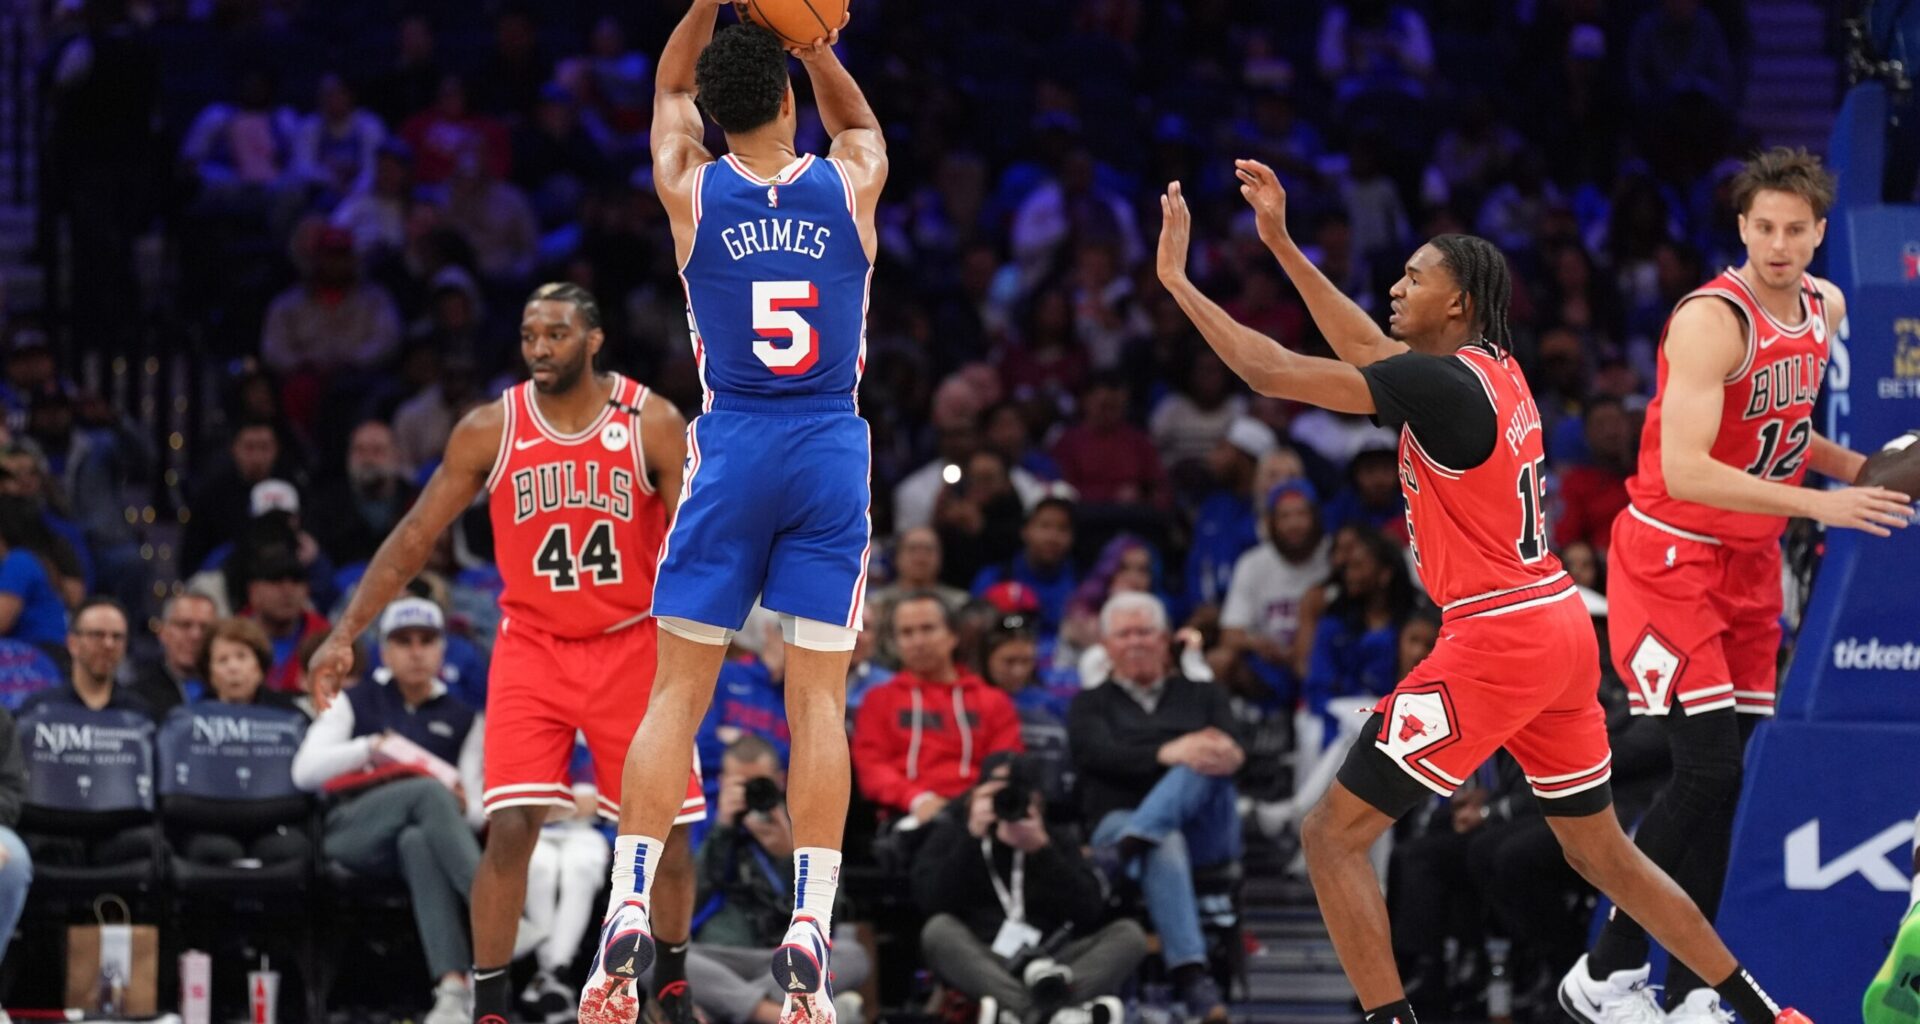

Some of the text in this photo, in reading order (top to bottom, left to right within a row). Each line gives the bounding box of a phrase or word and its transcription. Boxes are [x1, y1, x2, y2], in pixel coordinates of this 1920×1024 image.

[721, 218, 831, 261] GRIMES
[752, 280, 820, 376] 5
[1878, 378, 1920, 399] BET
[1745, 416, 1813, 480] 12
[512, 459, 633, 525] BULLS
[533, 519, 624, 592] 44
[35, 723, 91, 754] NJM
[193, 714, 248, 747] NJM
